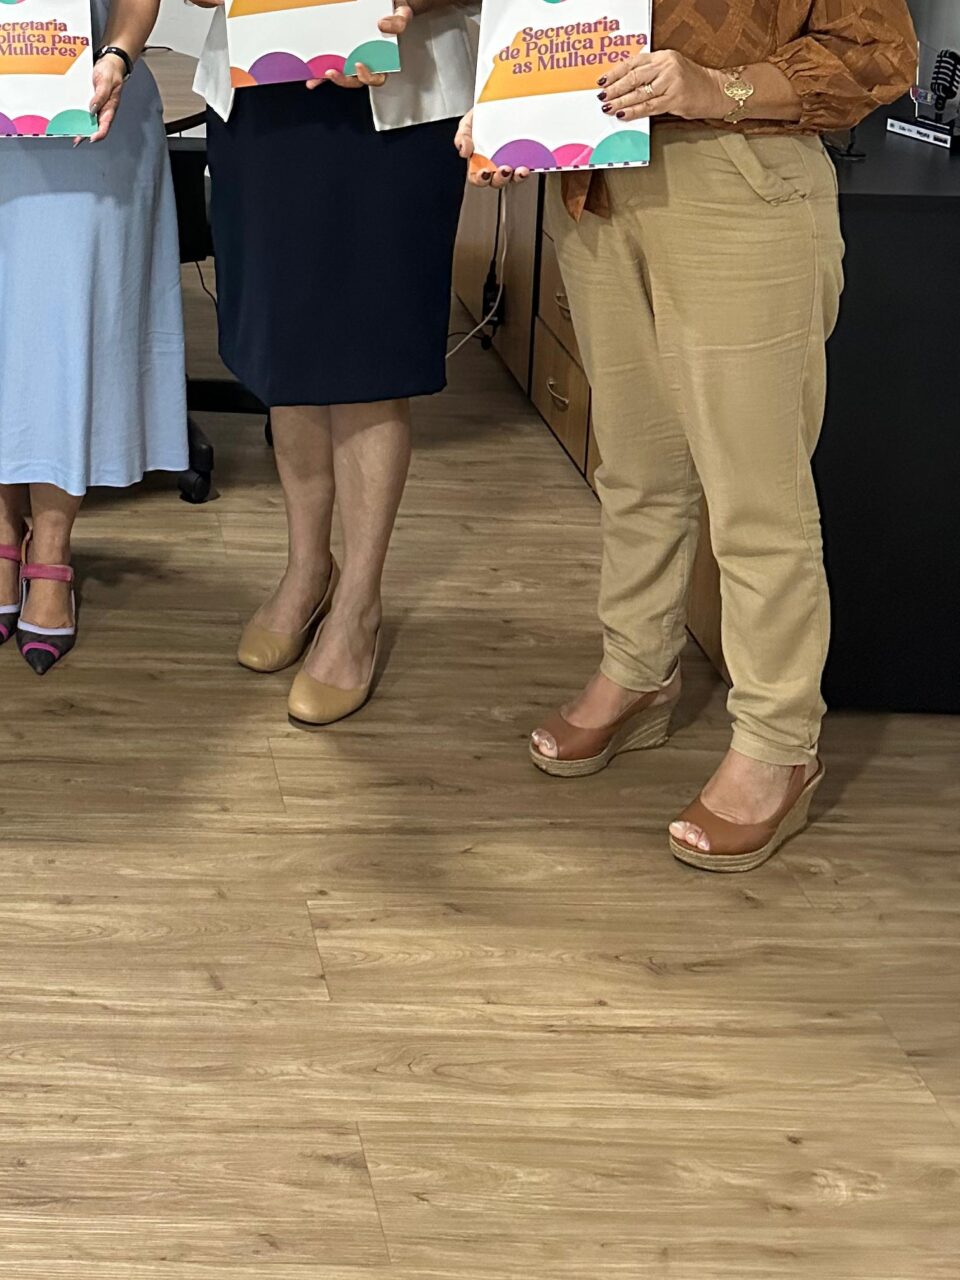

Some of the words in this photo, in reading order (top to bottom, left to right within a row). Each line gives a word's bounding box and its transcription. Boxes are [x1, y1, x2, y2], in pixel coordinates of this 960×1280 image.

[51, 35, 90, 47] para
[522, 16, 620, 43] Secretaria
[499, 46, 520, 62] de
[525, 37, 594, 58] Política
[600, 33, 648, 51] para
[512, 61, 533, 74] as
[537, 50, 630, 72] Mulheres
